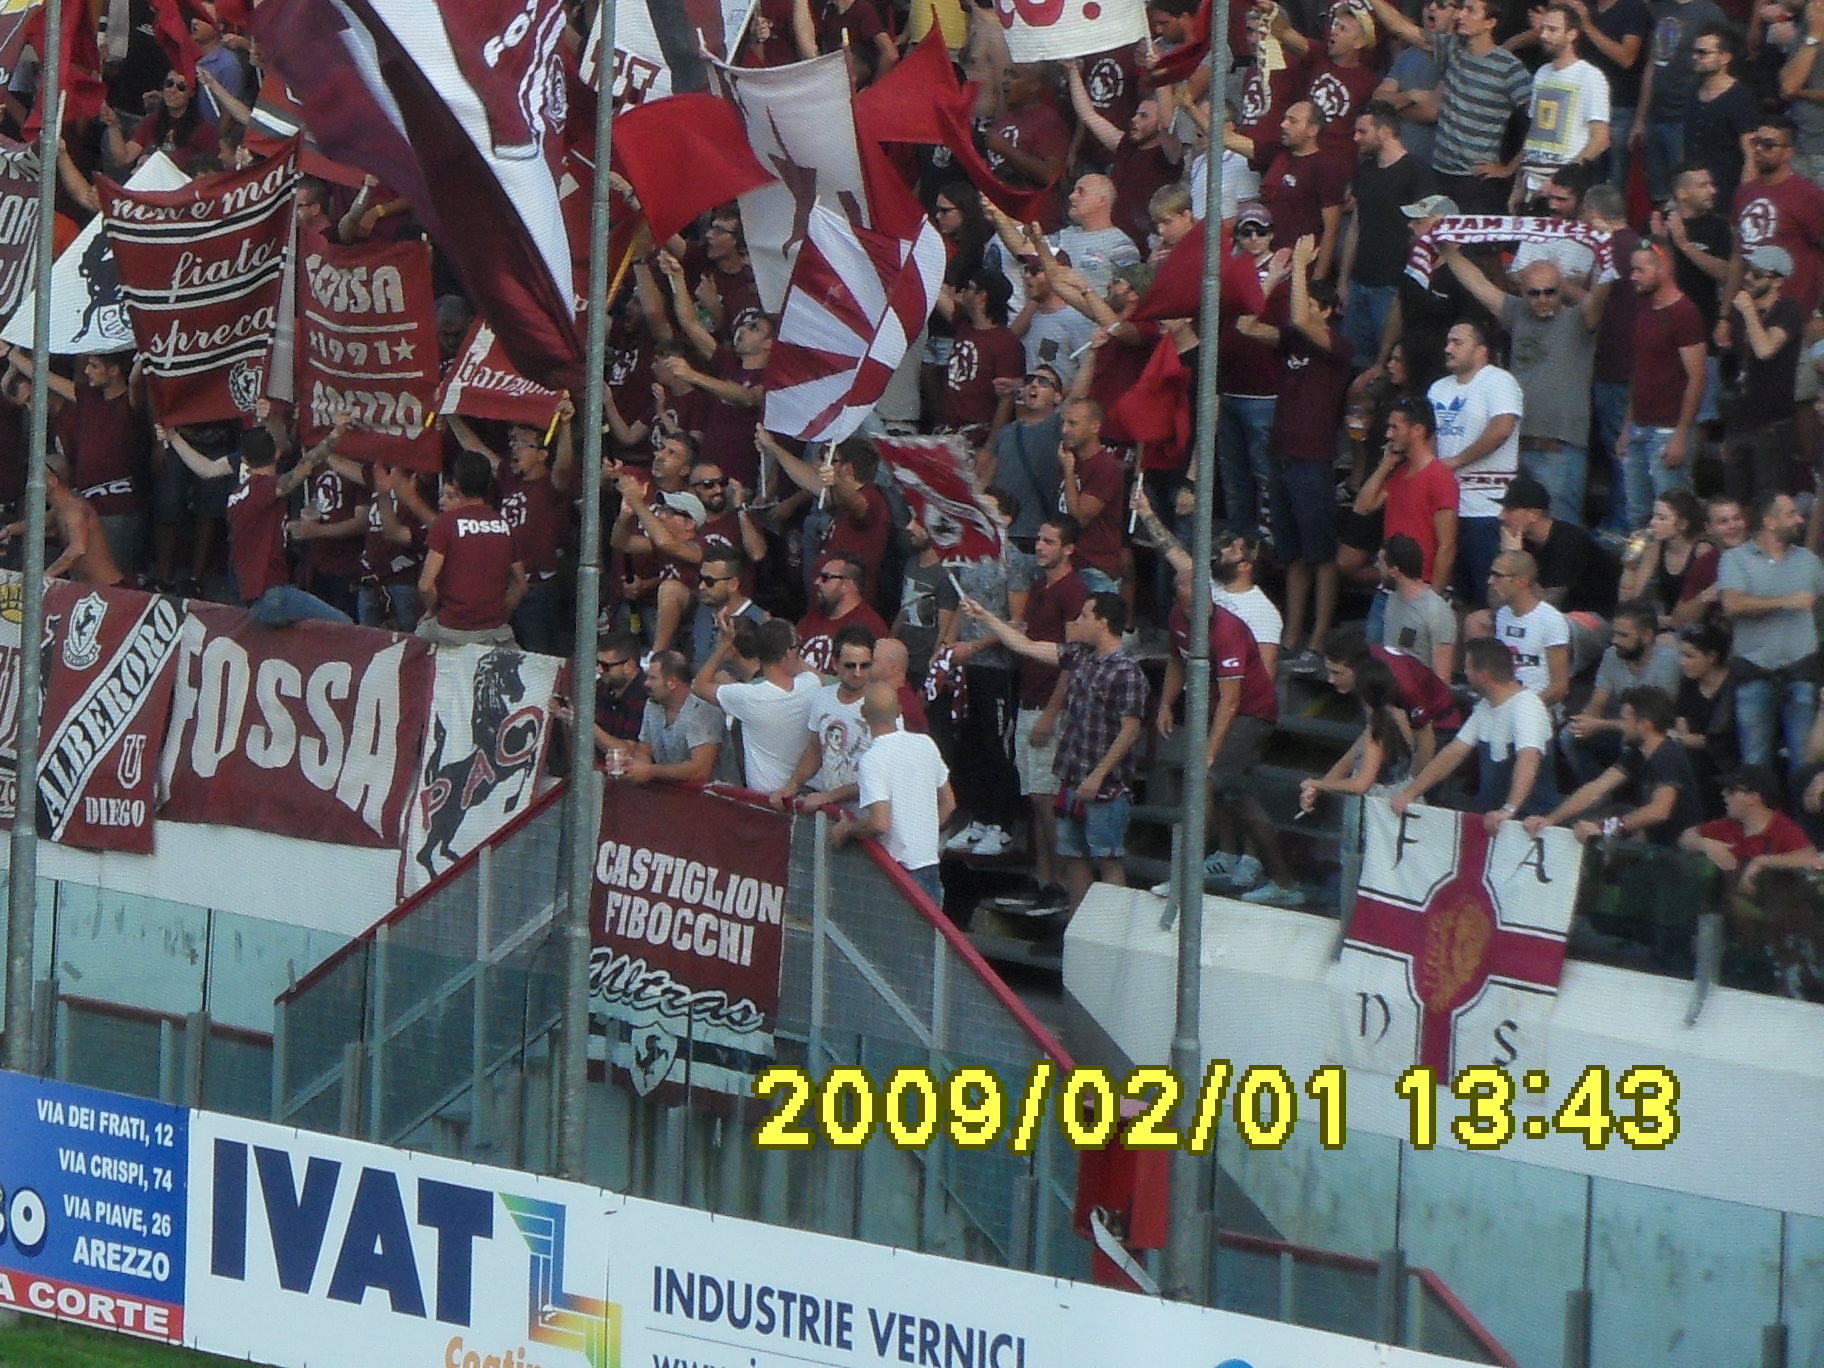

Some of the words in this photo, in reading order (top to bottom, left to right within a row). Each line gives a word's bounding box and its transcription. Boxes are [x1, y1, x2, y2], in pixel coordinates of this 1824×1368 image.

[168, 238, 276, 305] fiato
[456, 517, 512, 538] FOSSA
[35, 595, 181, 831] ALBERORO
[155, 610, 408, 840] FOSSA
[84, 796, 146, 829] DIEGO
[596, 839, 784, 925] CASTIGLION
[604, 890, 756, 967] FIBOCCHI
[36, 1098, 65, 1126] VIA
[67, 1104, 96, 1133] DEI
[98, 1110, 151, 1147] FRATI,
[154, 1121, 174, 1148] 12
[58, 1147, 87, 1176] VIA
[90, 1151, 150, 1192] CRISPI,
[152, 1167, 174, 1194] 74
[63, 1193, 92, 1222] VIA
[95, 1197, 149, 1237] PIAVE,
[151, 1211, 173, 1238] 26
[210, 1137, 495, 1328] IVAT
[72, 1235, 171, 1283] AREZZO
[28, 1281, 171, 1336] CORTE
[652, 1265, 854, 1352] INDUSTRIE
[867, 1307, 1027, 1368] VERNICI
